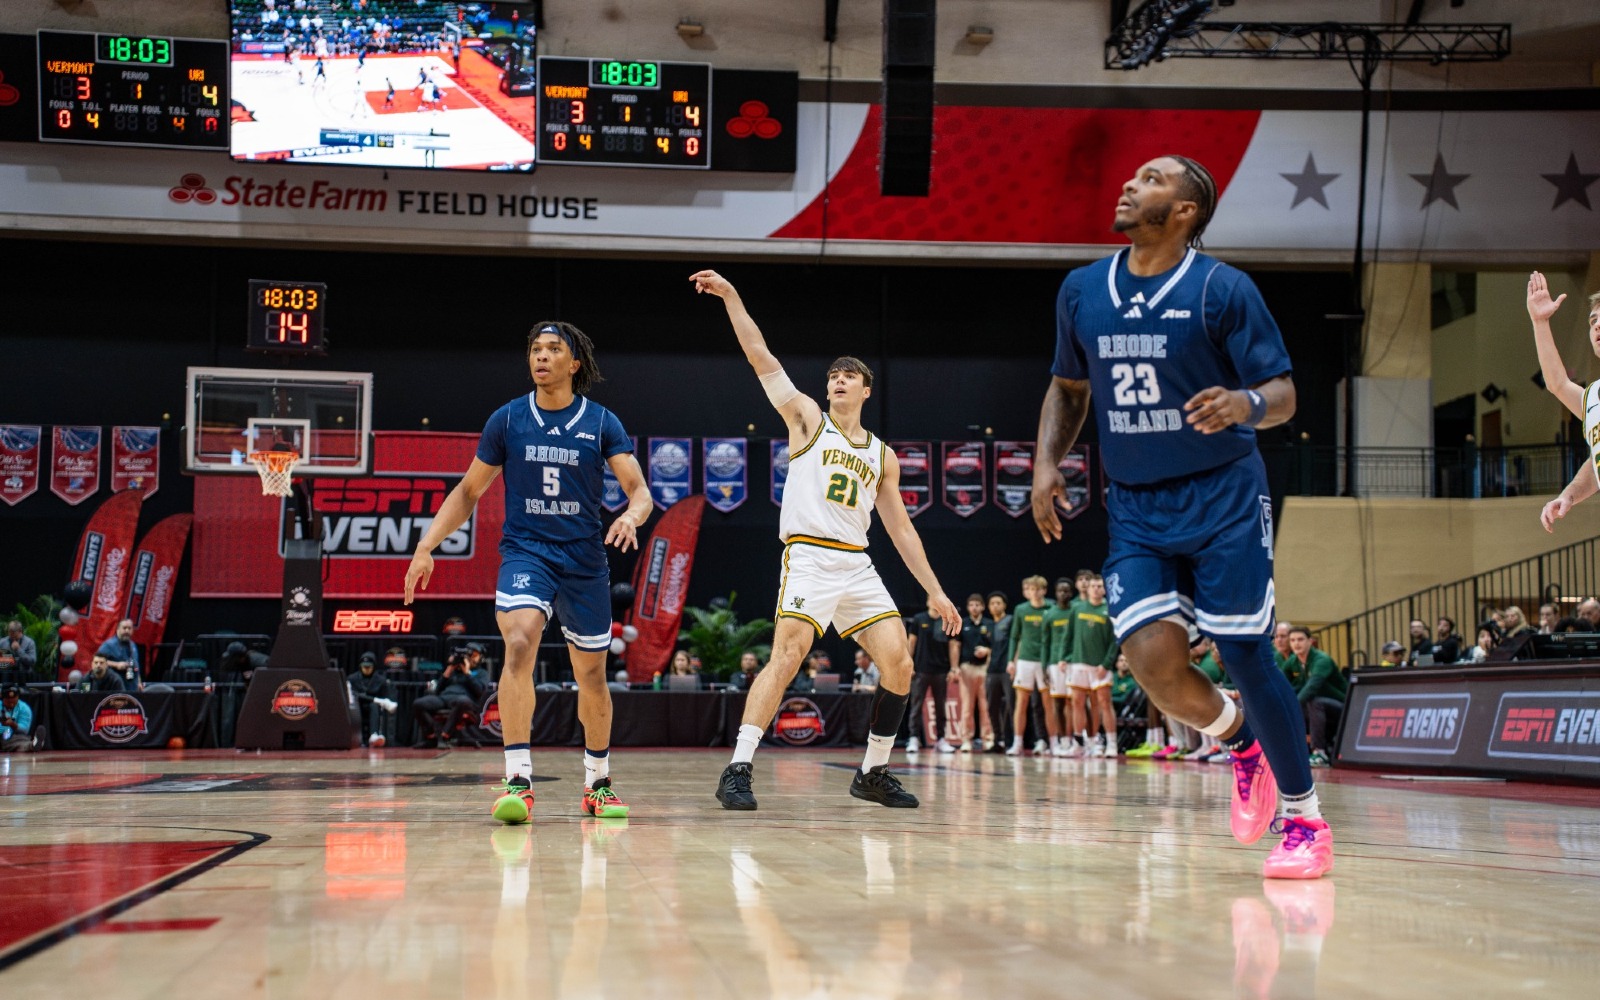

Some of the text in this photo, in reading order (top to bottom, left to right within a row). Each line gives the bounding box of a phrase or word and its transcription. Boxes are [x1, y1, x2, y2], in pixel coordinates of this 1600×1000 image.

[108, 38, 170, 63] 18:03
[48, 60, 94, 74] VERMONT
[122, 70, 149, 81] PERIOD
[601, 62, 656, 86] 18:03
[77, 76, 90, 100] 3
[136, 84, 142, 99] 1
[202, 86, 218, 106] 4
[546, 86, 588, 98] VERMONT
[49, 100, 74, 110] FOULS
[110, 104, 162, 114] PLAYER FOUL
[571, 101, 584, 124] 3
[624, 106, 631, 122] 1
[685, 106, 700, 126] 4
[58, 110, 71, 128] 0
[86, 112, 98, 129] 4
[173, 117, 185, 131] 4
[554, 132, 566, 150] 0
[579, 134, 592, 150] 4
[657, 137, 669, 154] 4
[686, 137, 698, 156] 0
[398, 190, 487, 216] FIELD
[497, 194, 598, 220] HOUSE
[264, 288, 318, 310] 18:03
[280, 312, 308, 344] 14
[1098, 334, 1168, 358] RHODE
[1112, 363, 1162, 406] 23
[1108, 409, 1182, 434] ISLAND
[525, 445, 580, 466] RHODE
[822, 448, 876, 488] VERMONT
[543, 466, 560, 496] 5
[826, 472, 858, 508] 21
[313, 478, 446, 513] ESPN
[525, 498, 580, 515] ISLAND
[84, 534, 100, 580] EVENTS
[134, 553, 151, 594] EVENTS
[334, 610, 413, 632] ESPN
[1365, 708, 1458, 740] ESPN EVENTS
[1501, 708, 1556, 742] ESPN
